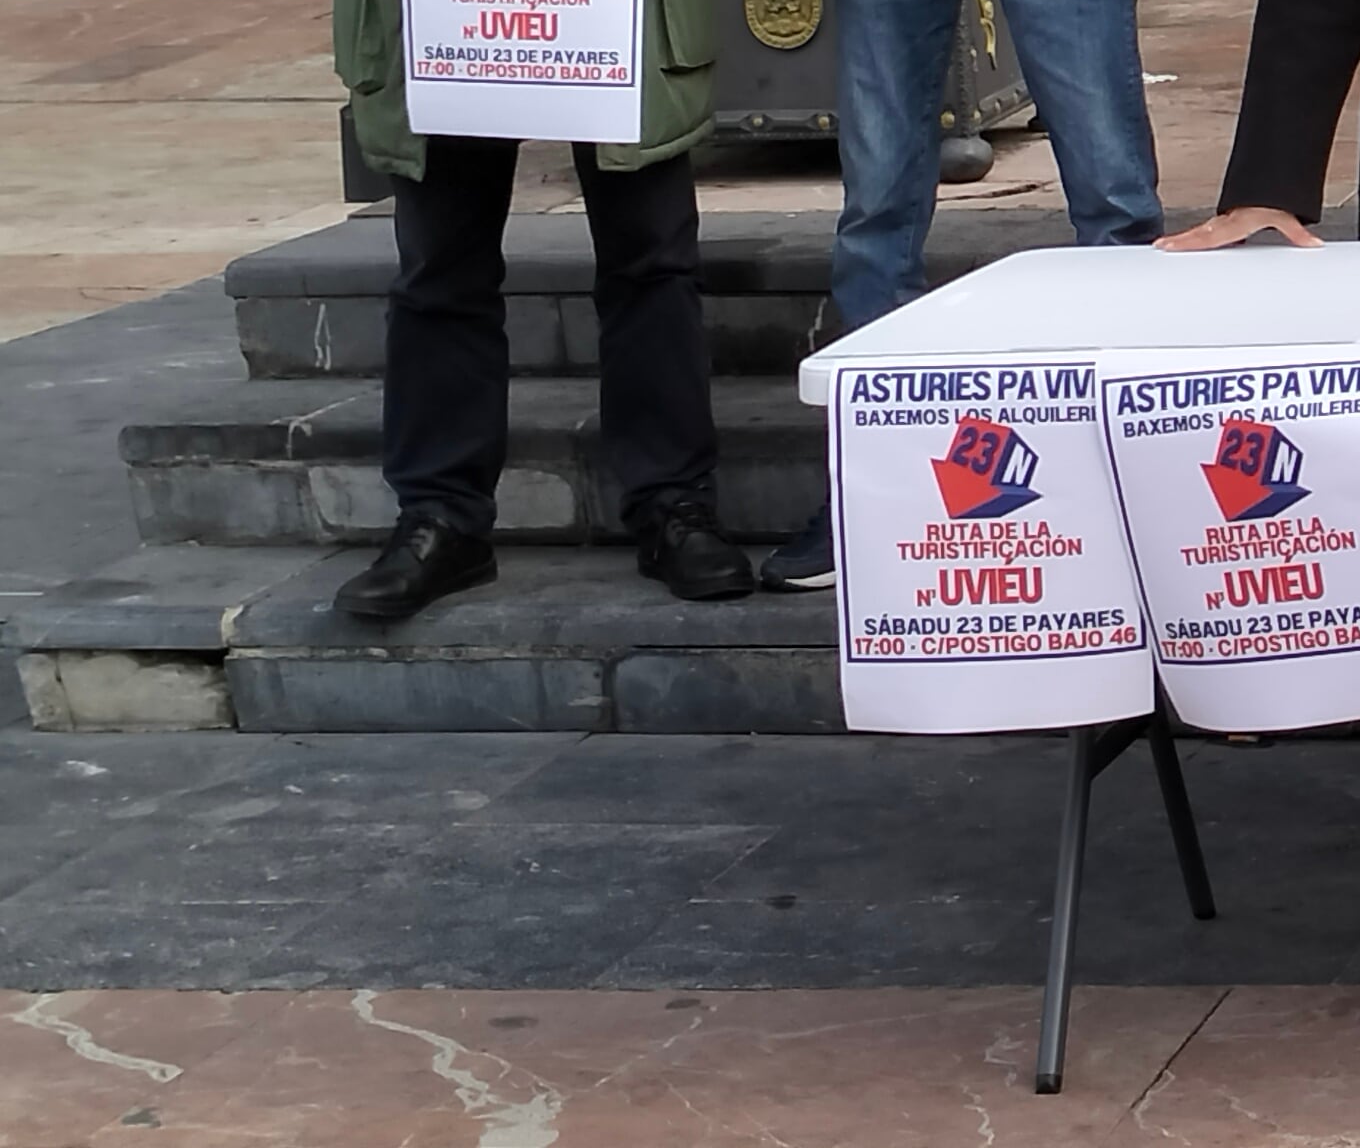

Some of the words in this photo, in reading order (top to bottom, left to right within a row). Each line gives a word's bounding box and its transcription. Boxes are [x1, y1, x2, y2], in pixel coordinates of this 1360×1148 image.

[424, 42, 488, 61] SÁBADU
[492, 48, 512, 62] 23
[516, 49, 537, 63] DE
[542, 49, 618, 64] PAYARES
[850, 371, 990, 403] ASTURIES
[997, 370, 1037, 400] PA
[1116, 373, 1254, 414] ASTURIES
[1261, 370, 1301, 399] PA
[854, 637, 904, 654] 17:00
[920, 634, 1041, 655] C/POSTIGO
[1047, 630, 1103, 650] BAJO
[1110, 626, 1136, 644] 46
[1163, 617, 1241, 640] SÁBADU
[1247, 615, 1272, 634] 23
[1276, 612, 1304, 631] DE
